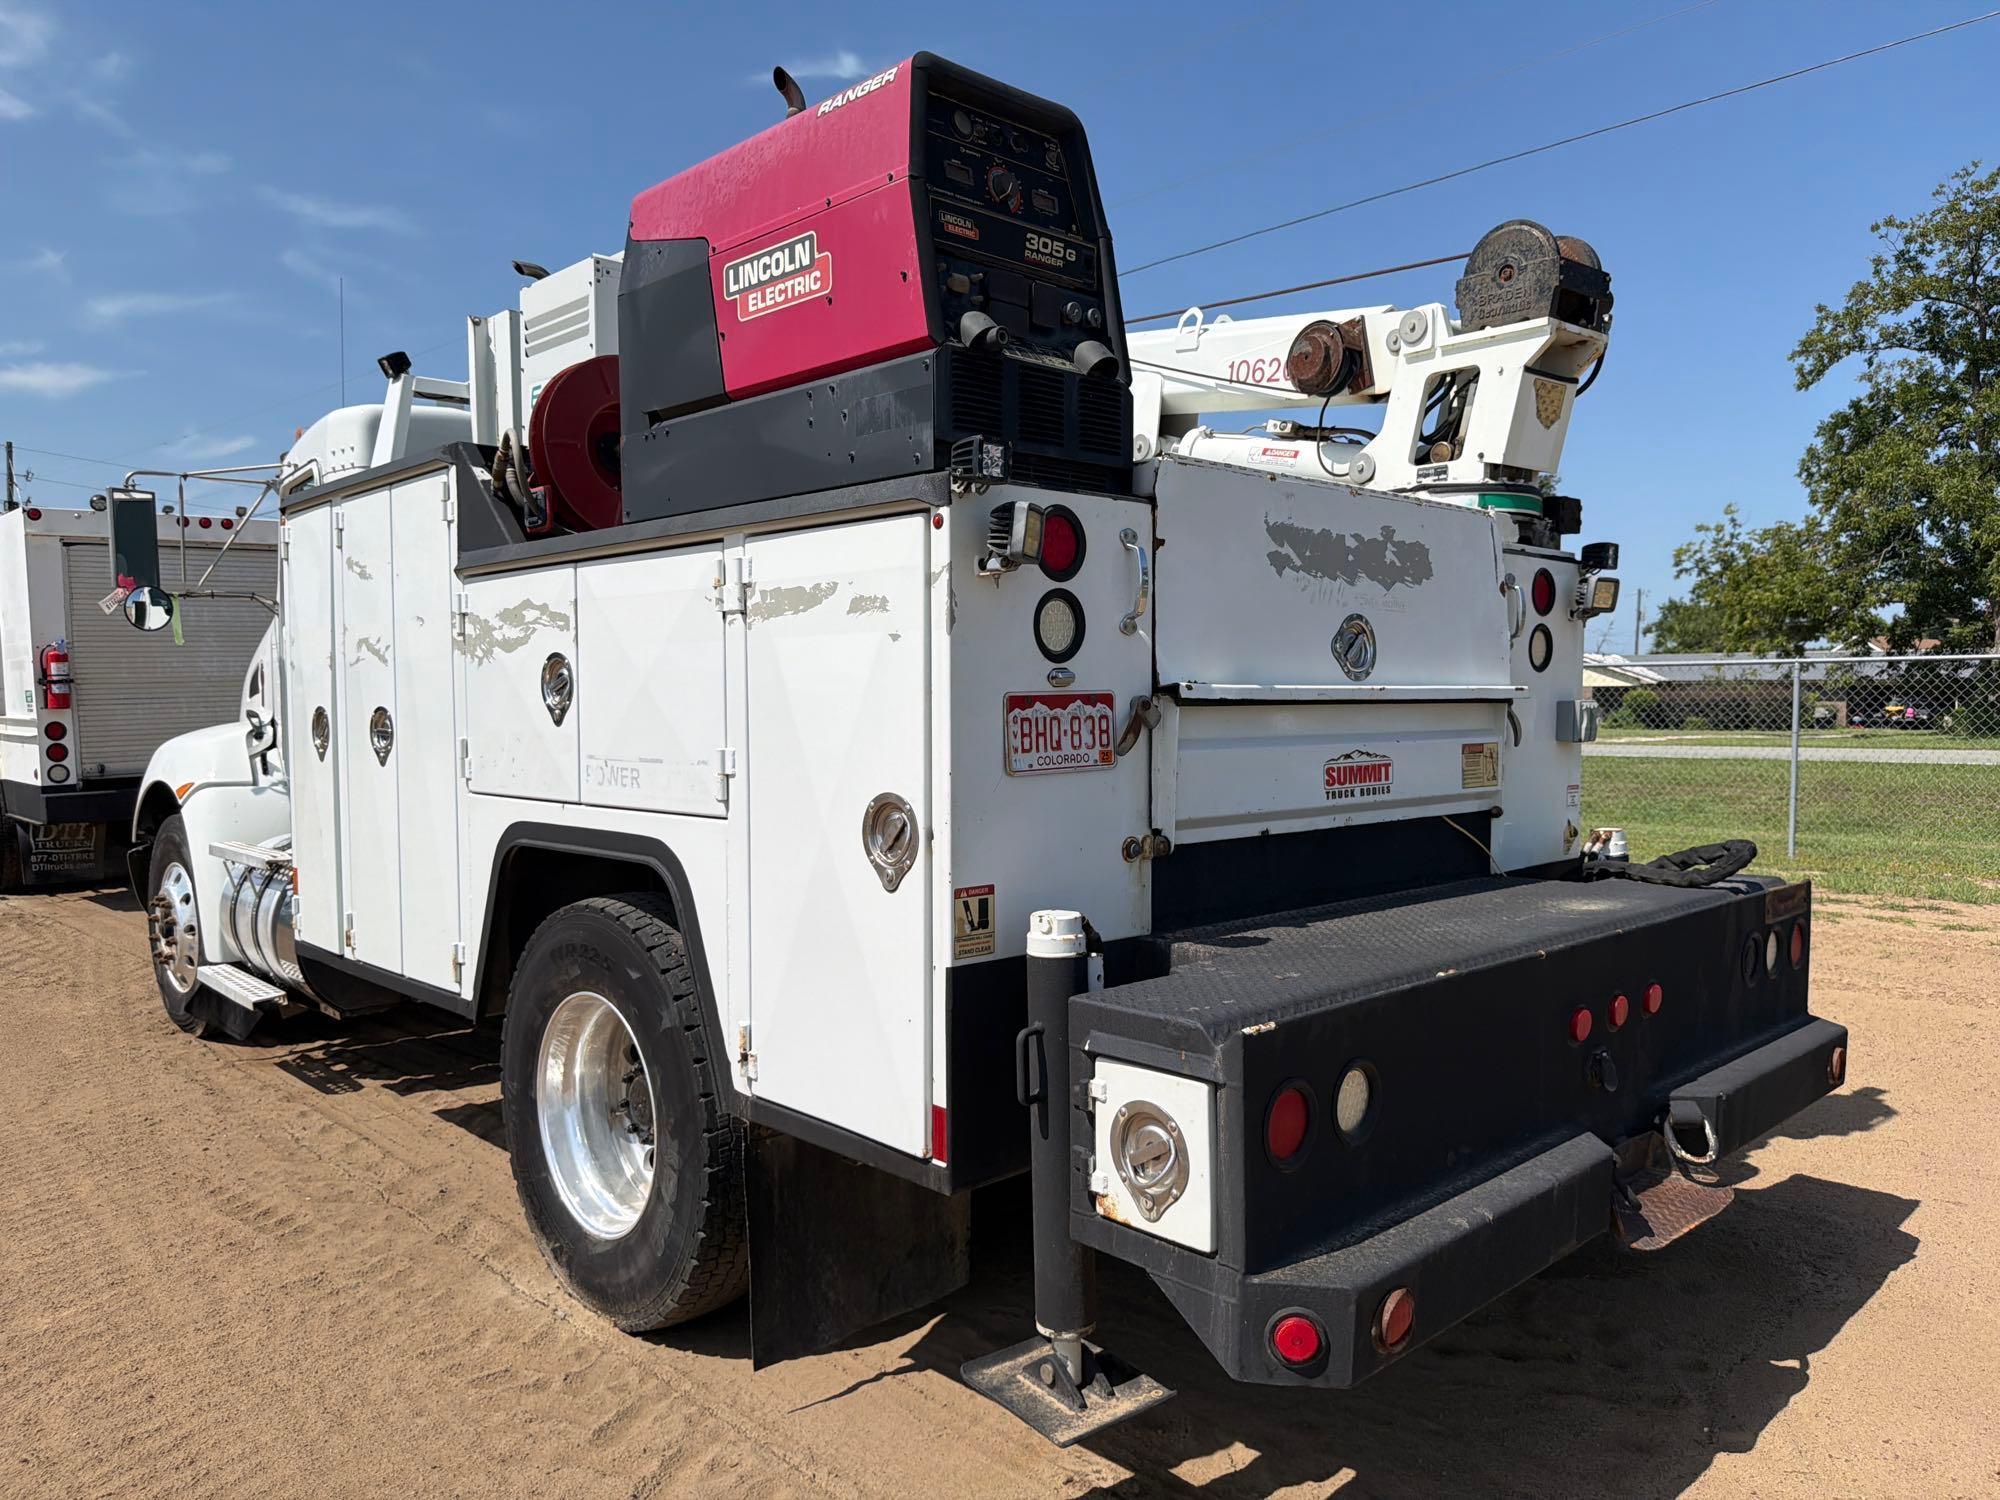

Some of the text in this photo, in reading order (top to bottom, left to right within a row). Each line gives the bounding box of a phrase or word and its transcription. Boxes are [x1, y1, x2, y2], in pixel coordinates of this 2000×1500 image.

[817, 66, 899, 117] RANGER
[941, 212, 972, 229] LINCOLN
[949, 225, 976, 239] ELECTRIC
[728, 240, 810, 293] LINCOLN
[1024, 249, 1065, 268] RANGER
[748, 270, 821, 312] ELECTRIC
[1479, 287, 1532, 308] BRADEN
[1269, 449, 1295, 457] DANGER
[1037, 753, 1090, 767] COLORADO
[1325, 763, 1391, 787] SUMMIT
[1325, 786, 1391, 800] TRUCK BODIES
[35, 823, 91, 841] DTI
[35, 840, 91, 849] TRUCKS
[968, 887, 989, 896] DANGER
[958, 945, 991, 956] STAND CLEAR
